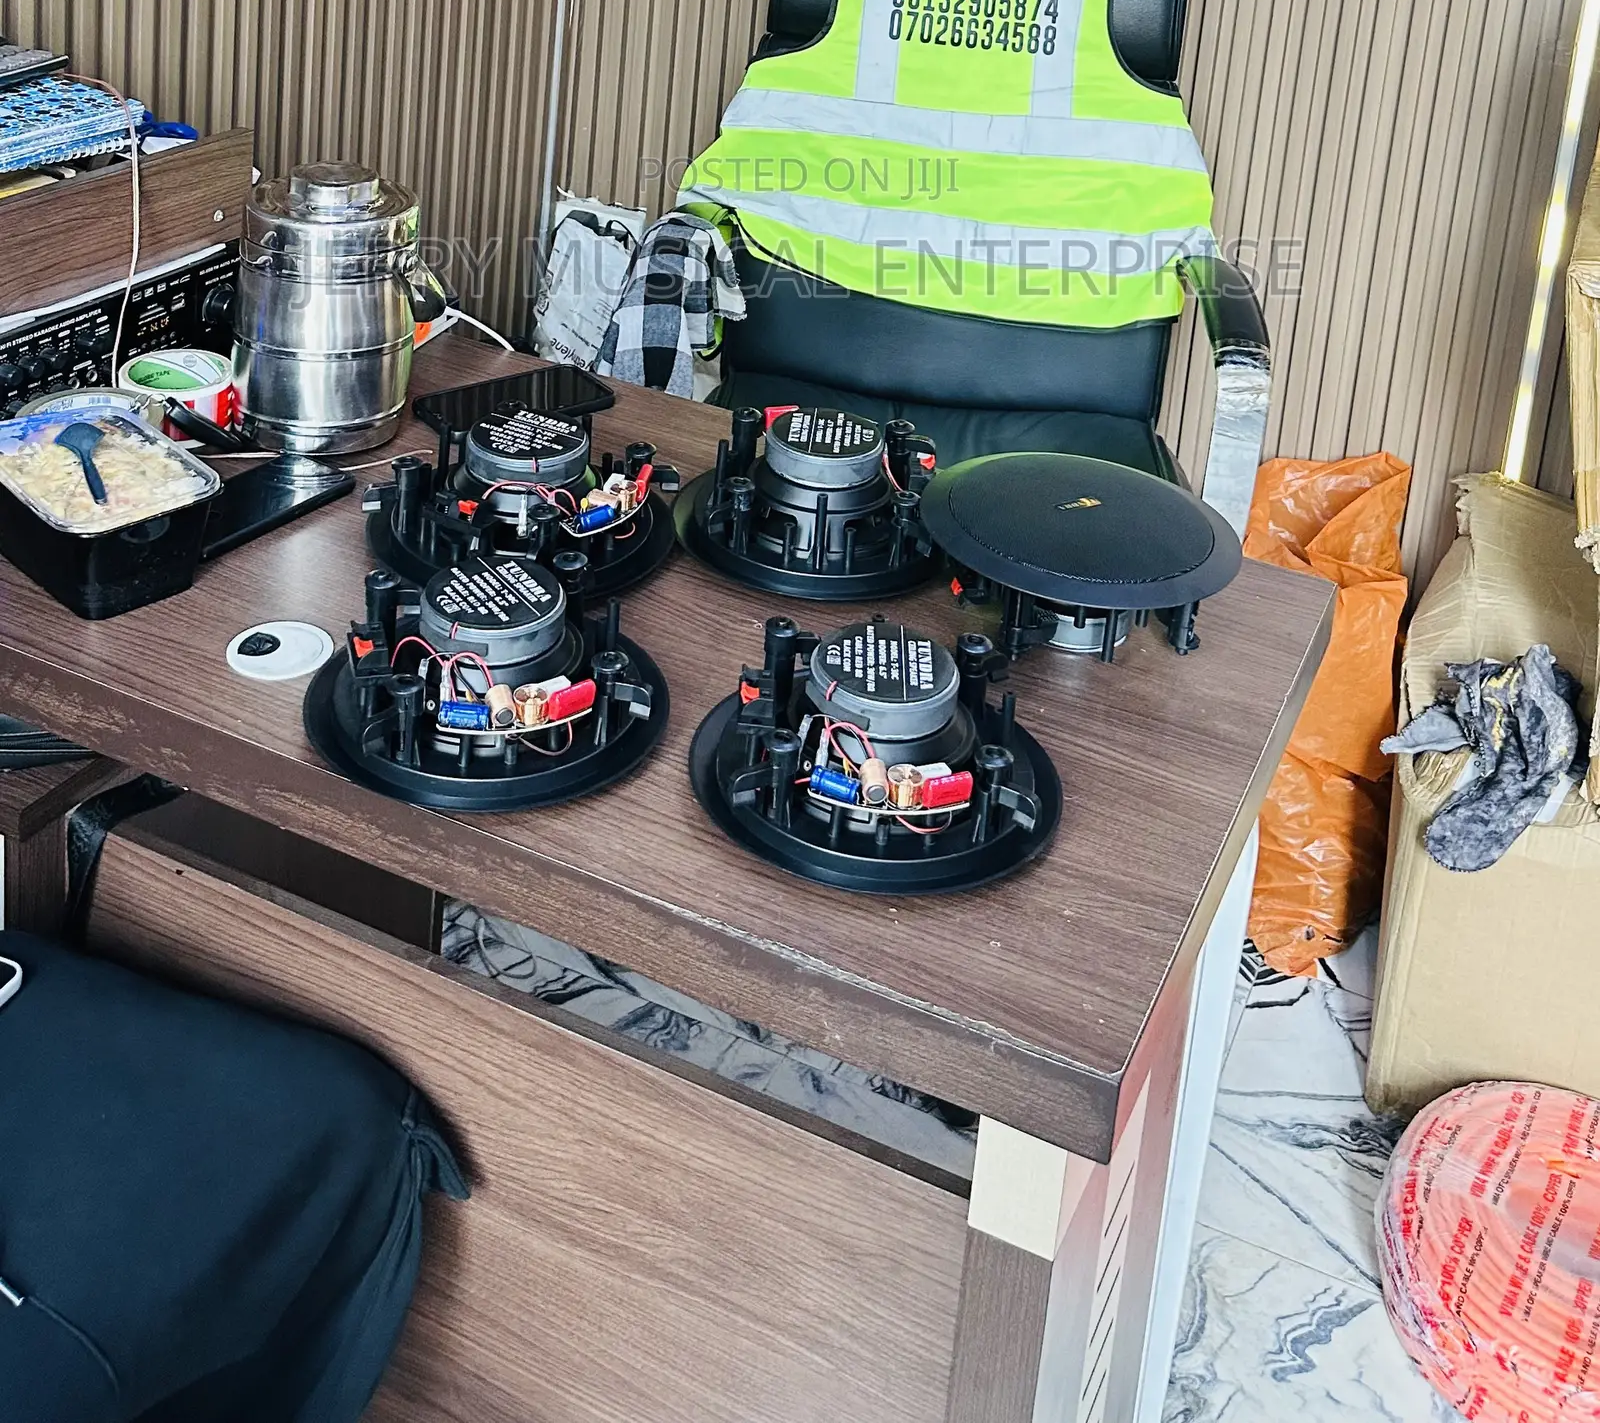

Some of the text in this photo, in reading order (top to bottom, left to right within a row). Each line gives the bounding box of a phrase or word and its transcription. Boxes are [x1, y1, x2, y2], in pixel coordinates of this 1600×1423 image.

[888, 9, 1058, 56] 07026634588
[12, 332, 34, 349] STEREO
[34, 325, 60, 341] KARAOKE
[518, 410, 578, 432] TUNDRA
[503, 560, 552, 603] TUNDRA
[918, 640, 934, 689] TUNDRA
[1498, 1287, 1519, 1318] VIMA
[1519, 1225, 1539, 1254] CABLE
[1529, 1201, 1549, 1229] 100%
[1525, 1289, 1537, 1305] OFC
[1549, 1215, 1563, 1239] CABLE
[1558, 1197, 1570, 1218] 100%
[1453, 1293, 1465, 1317] AND
[1459, 1266, 1473, 1295] CABLE
[1551, 1345, 1575, 1382] ABLE
[1577, 1354, 1590, 1375] AND
